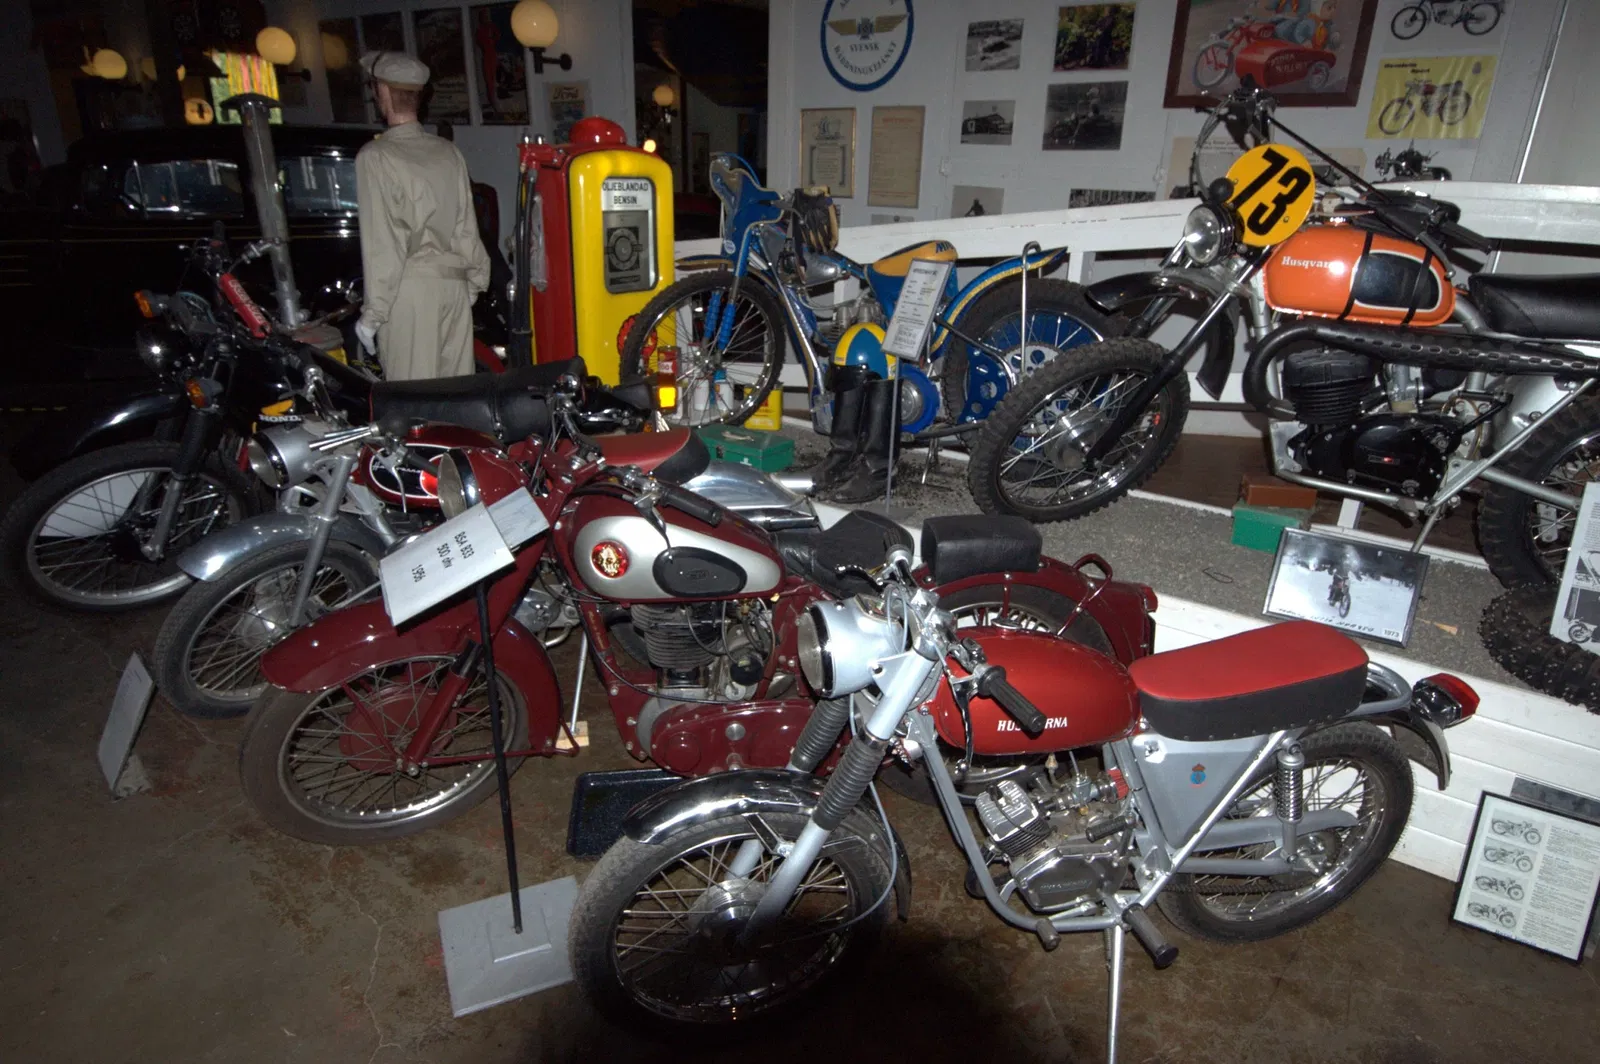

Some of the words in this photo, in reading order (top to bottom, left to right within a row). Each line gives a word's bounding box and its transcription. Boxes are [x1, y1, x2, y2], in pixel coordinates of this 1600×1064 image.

[602, 181, 649, 191] OLJEBLANDAD
[1230, 147, 1312, 236] 73
[613, 195, 638, 205] BENSIN
[1281, 256, 1343, 273] Husqvar
[454, 531, 468, 547] BSA
[436, 542, 452, 557] 500
[460, 543, 475, 559] B33
[411, 564, 427, 583] 1956
[997, 716, 1068, 732] HURNA
